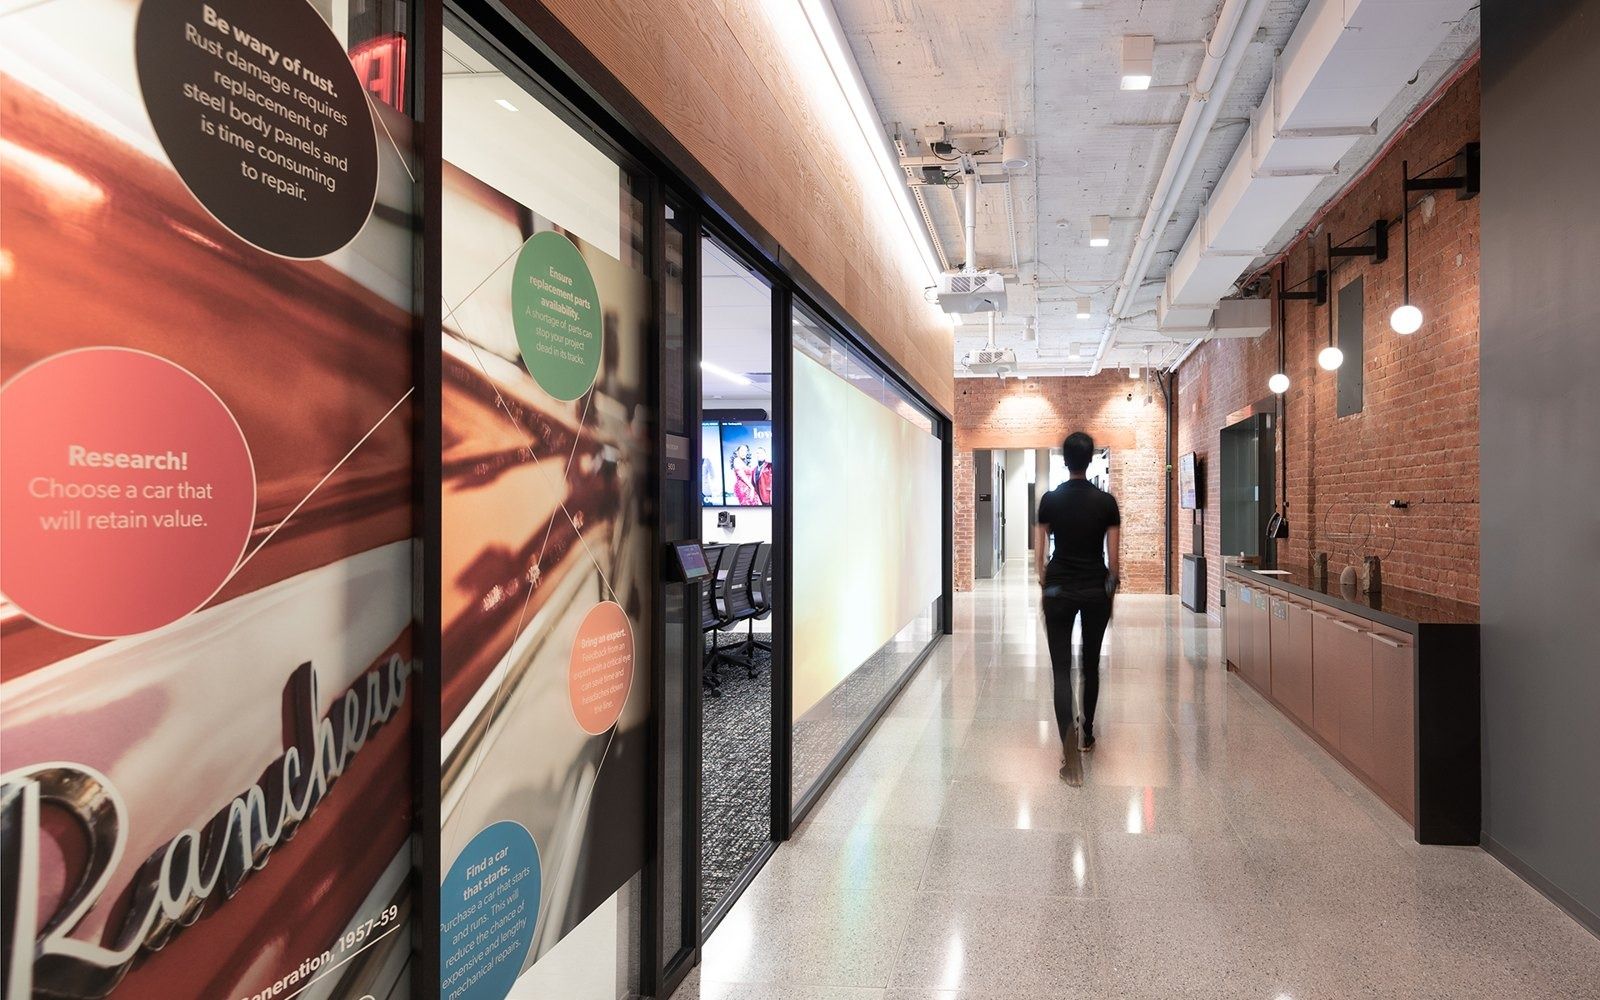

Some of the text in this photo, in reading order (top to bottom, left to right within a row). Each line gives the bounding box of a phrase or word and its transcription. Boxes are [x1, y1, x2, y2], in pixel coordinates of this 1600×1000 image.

[203, 4, 230, 35] Be
[233, 25, 280, 66] wary
[283, 56, 302, 75] of
[303, 67, 338, 98] rust.
[184, 23, 348, 126] Rust damage requires
[183, 82, 348, 172] steel body panels and
[213, 70, 311, 132] replacement
[314, 123, 329, 139] of
[201, 115, 336, 193] is time consuming
[241, 160, 308, 202] to repair.
[529, 275, 591, 310] replacement parts
[549, 265, 573, 286] Ensure
[69, 445, 188, 470] Research!
[28, 476, 213, 499] Choose a car that
[40, 510, 207, 530] will retain value.
[463, 864, 511, 901] that starts.
[466, 846, 509, 881] Find a car
[477, 900, 483, 910] a
[483, 890, 497, 905] car
[496, 879, 511, 896] that
[511, 866, 530, 885] starts
[445, 899, 525, 969] reduce the chance of
[452, 923, 469, 946] and
[491, 900, 506, 916] This
[241, 949, 335, 1000] neration,
[442, 916, 527, 989] expensive and lengthy
